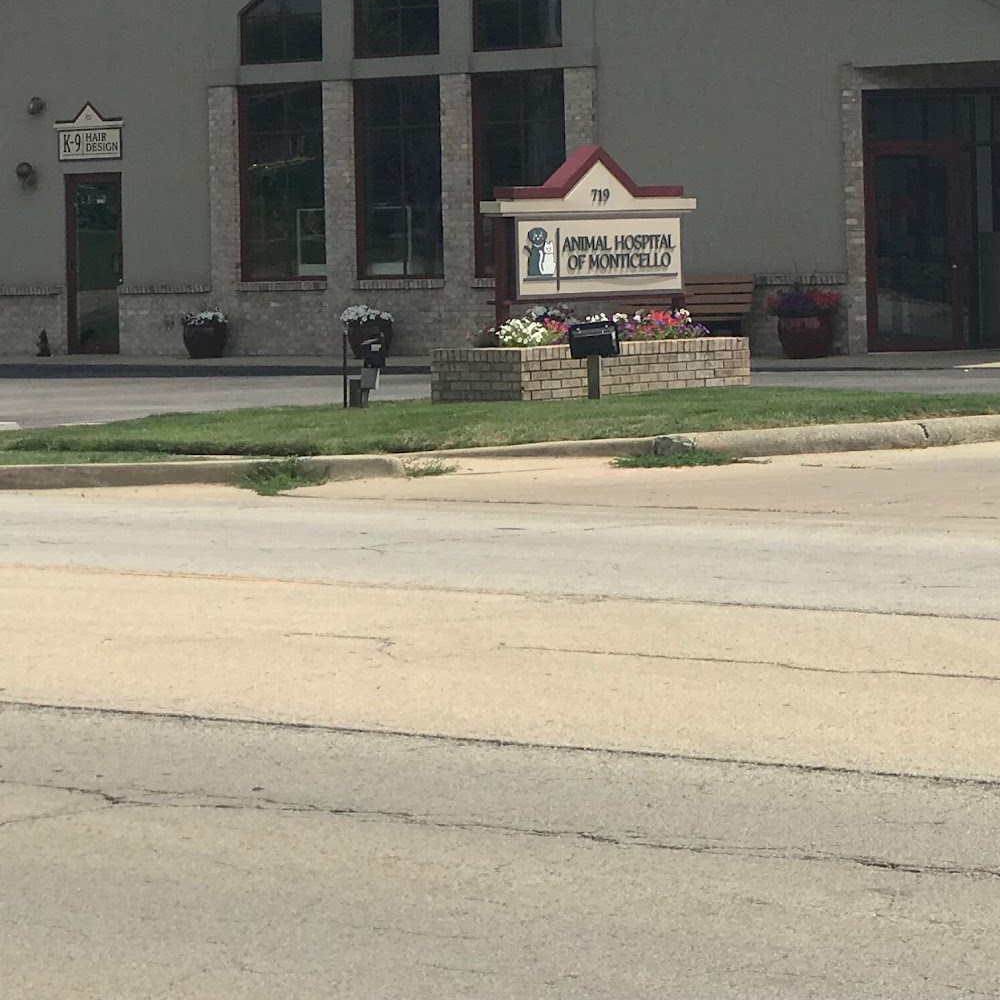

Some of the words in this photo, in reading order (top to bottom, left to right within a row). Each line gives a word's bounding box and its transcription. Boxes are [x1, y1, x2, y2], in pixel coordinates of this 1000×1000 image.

[63, 133, 81, 153] K-9
[85, 133, 107, 142] HAIR
[85, 142, 118, 152] DESIGN
[590, 188, 610, 204] 719
[562, 235, 612, 252] ANIMAL
[615, 233, 676, 250] HOSPITAL
[567, 254, 586, 271] OF
[588, 251, 672, 270] MONTICELLO
